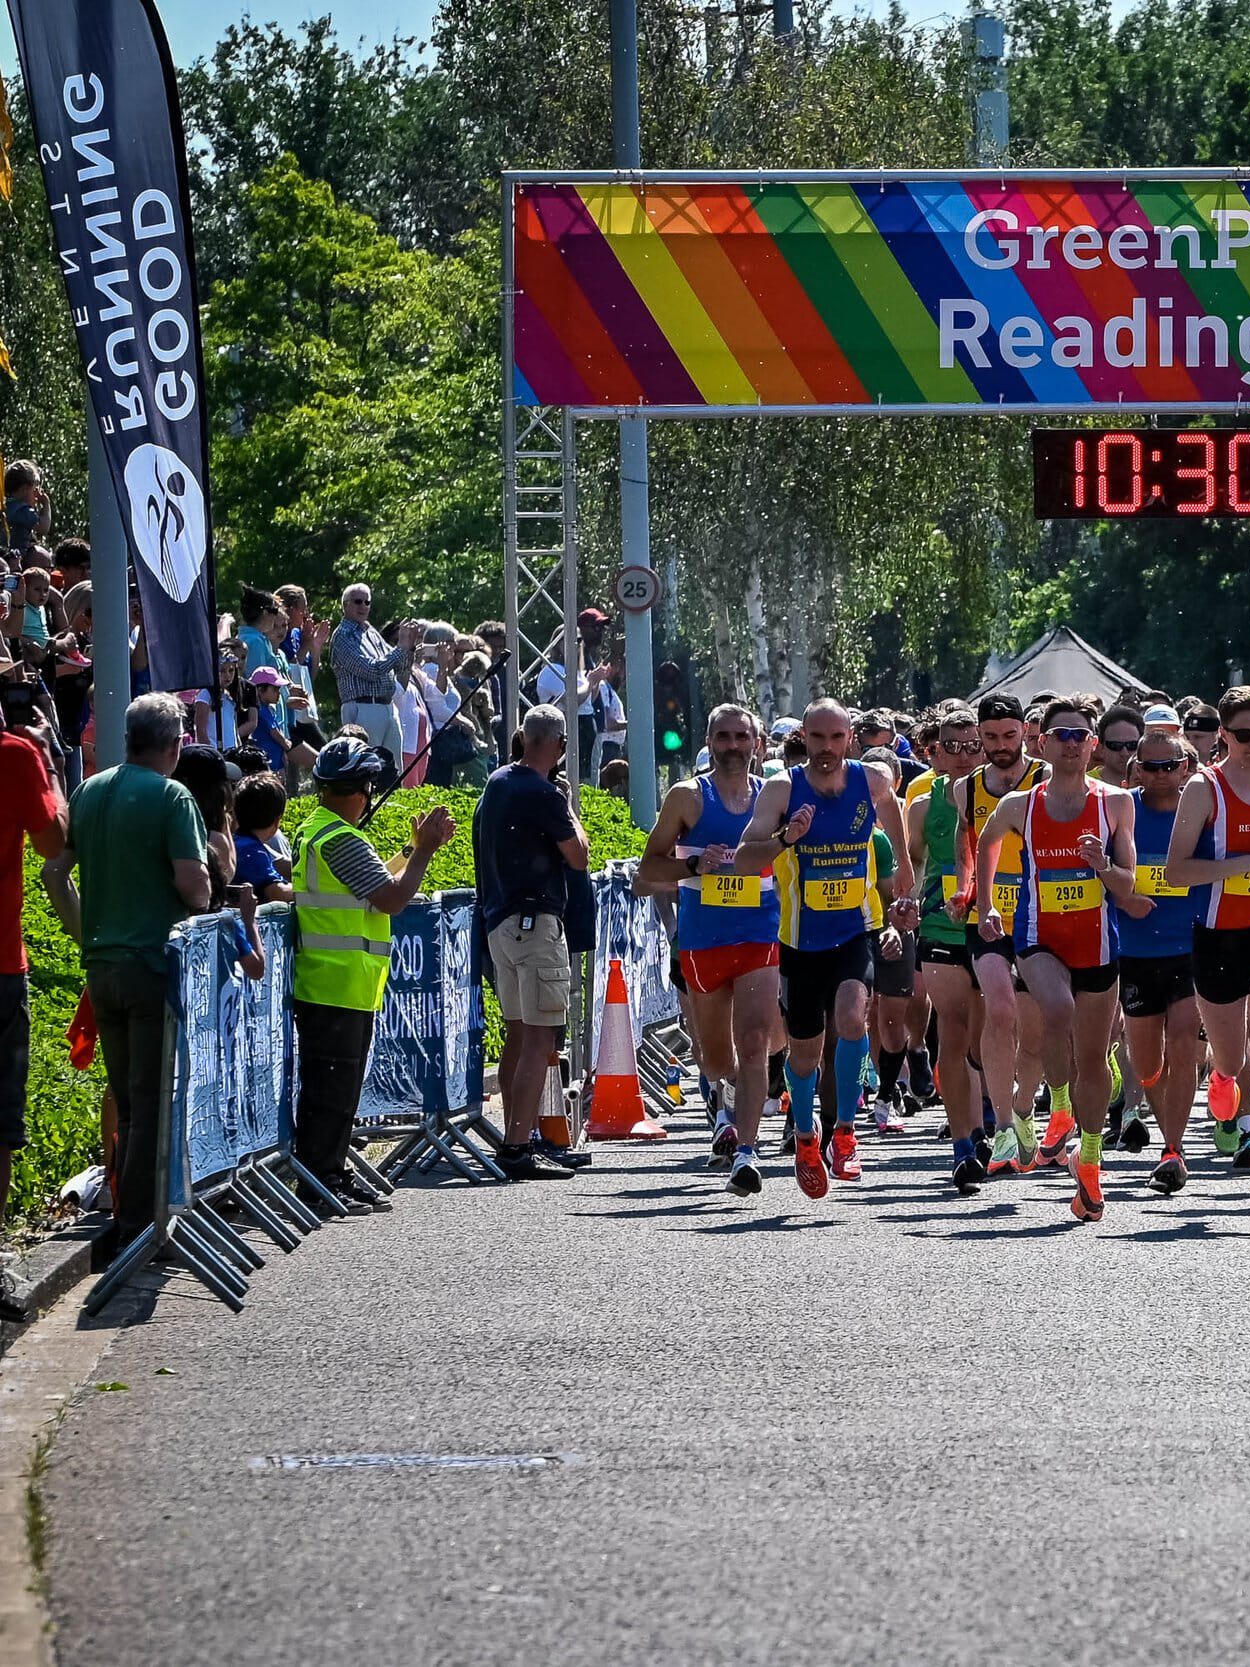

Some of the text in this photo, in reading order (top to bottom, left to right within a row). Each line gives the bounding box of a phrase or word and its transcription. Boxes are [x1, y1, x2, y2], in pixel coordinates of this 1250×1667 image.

[623, 581, 648, 598] 25
[799, 842, 868, 854] Hatch Warre
[1035, 847, 1081, 857] READING
[812, 856, 858, 867] Runners
[717, 877, 744, 891] 2040
[822, 881, 848, 896] 2813
[1055, 885, 1084, 901] 2928
[390, 934, 424, 981] OOD
